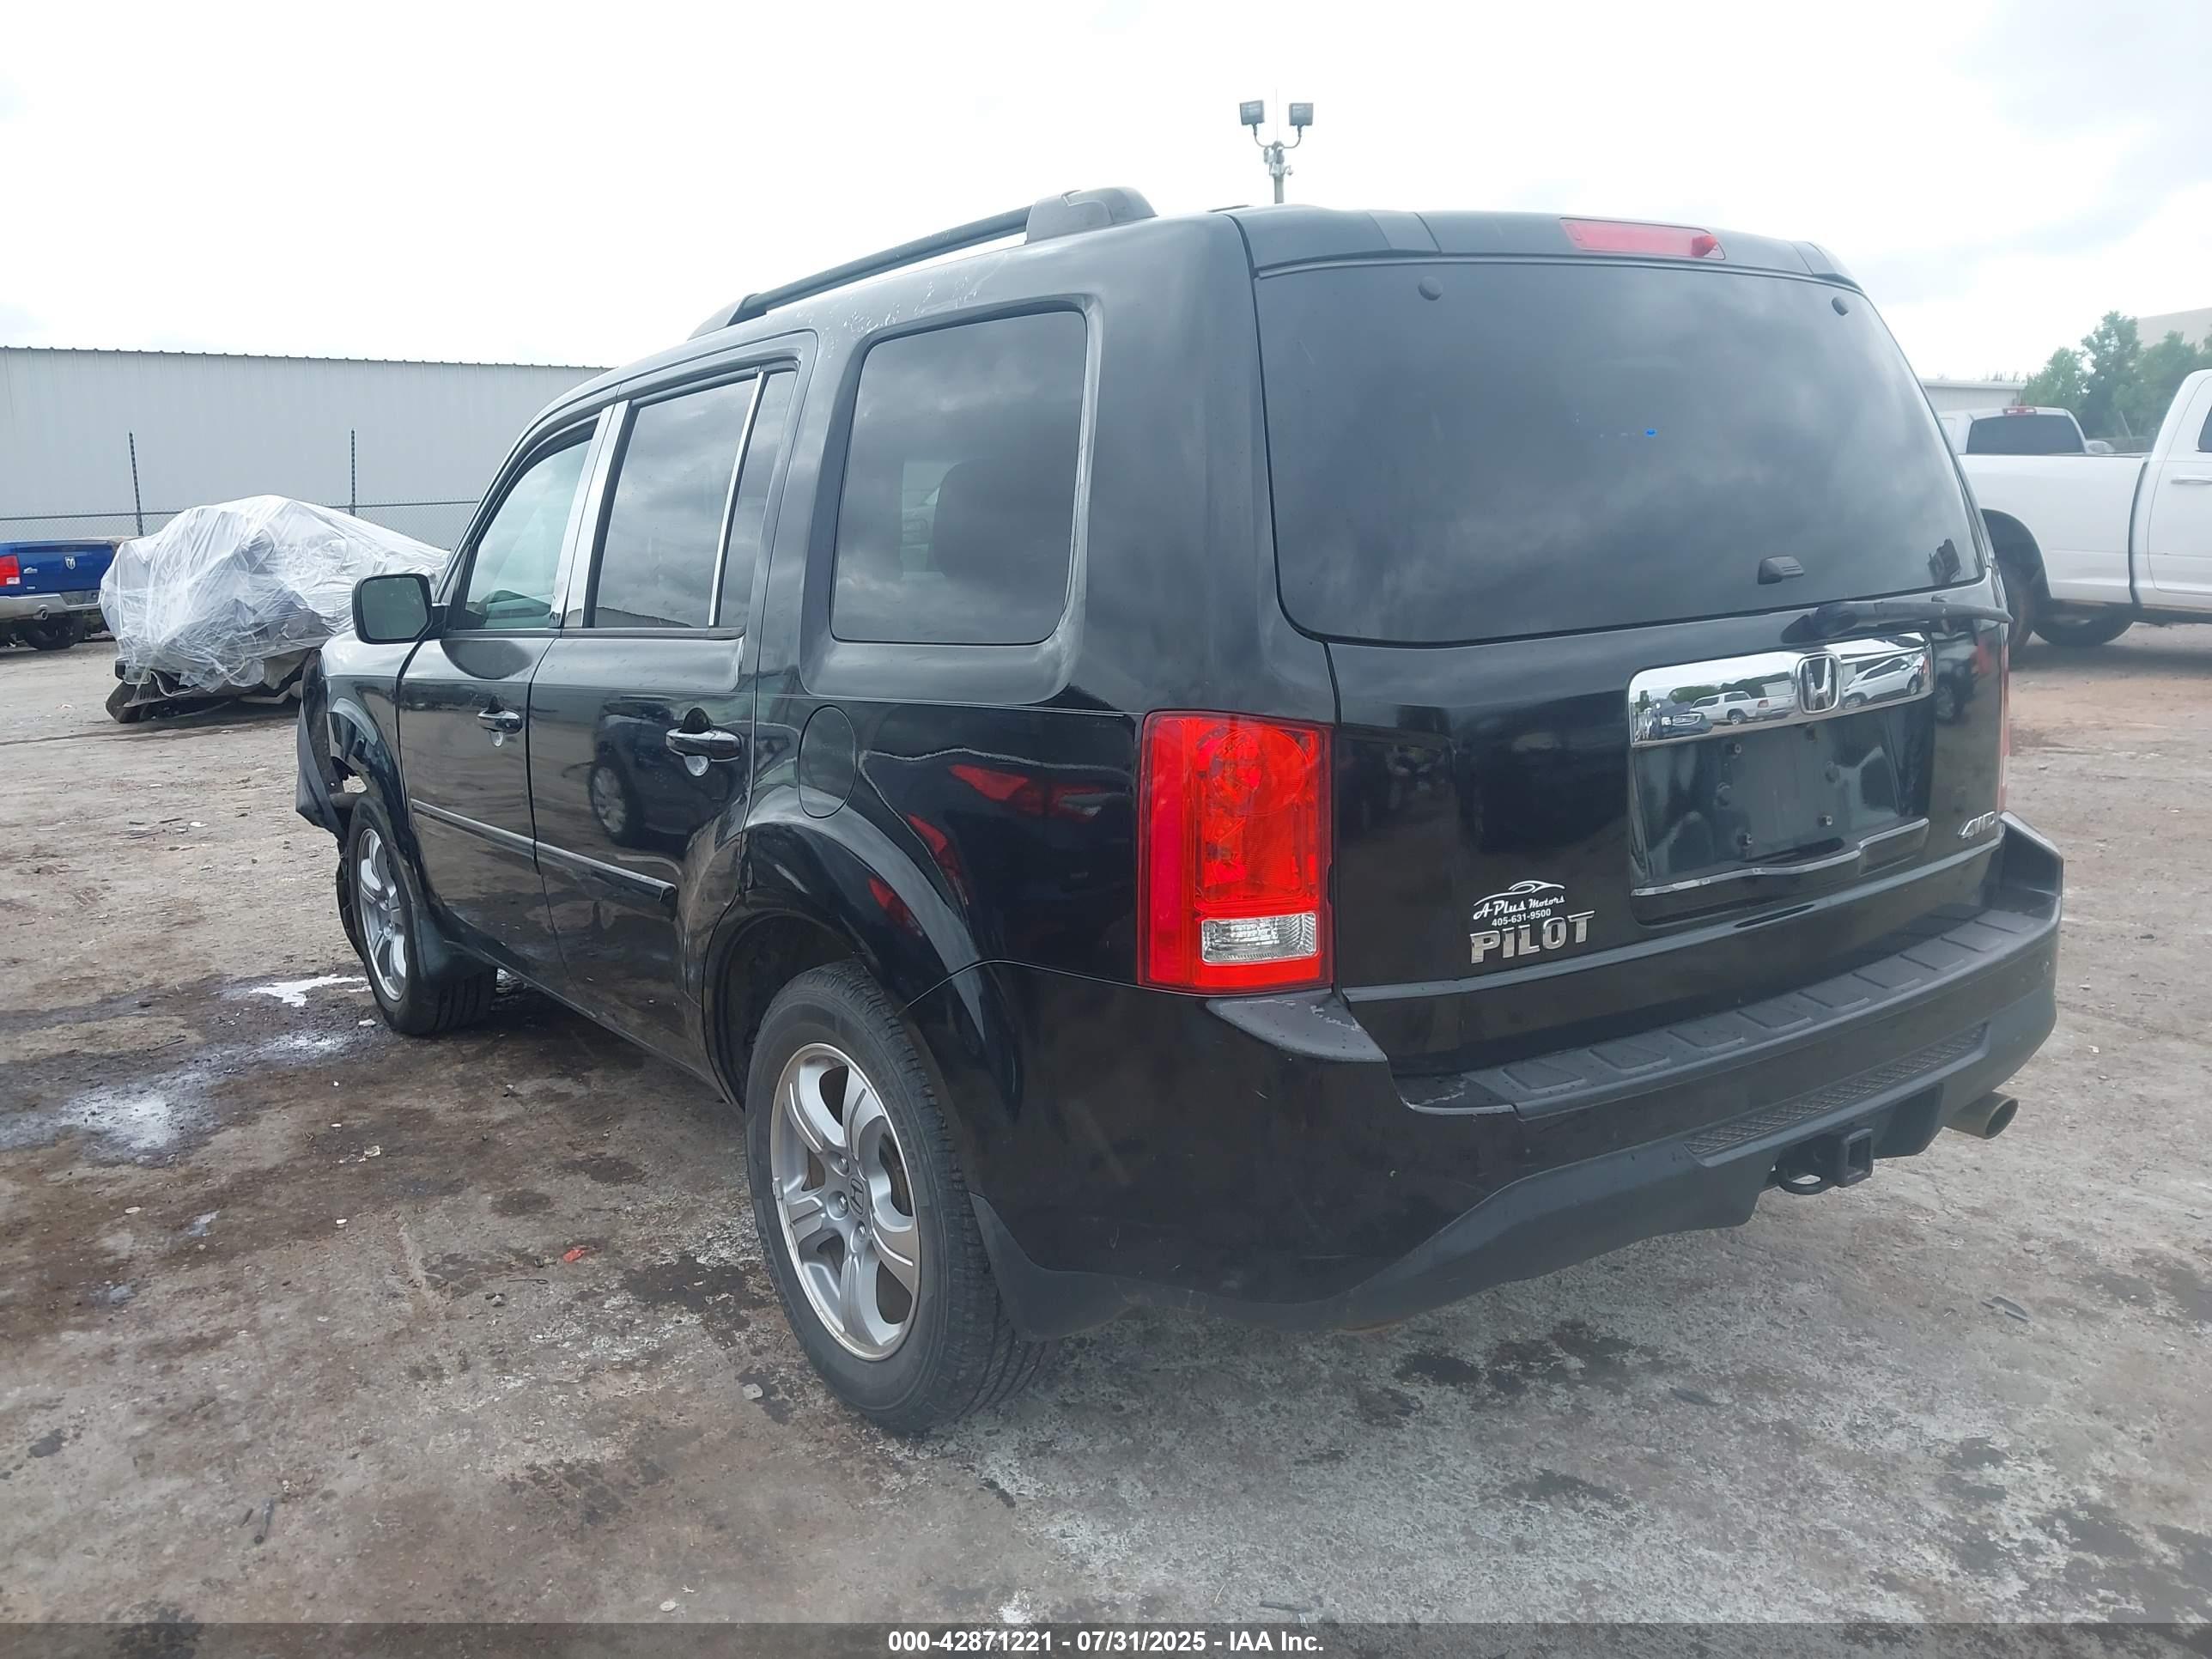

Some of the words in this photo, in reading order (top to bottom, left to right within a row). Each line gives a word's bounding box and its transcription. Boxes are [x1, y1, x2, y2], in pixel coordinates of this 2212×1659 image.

[1528, 895, 1565, 909] Motors
[1492, 908, 1552, 927] 405-631-9500
[1470, 909, 1595, 964] PILOT
